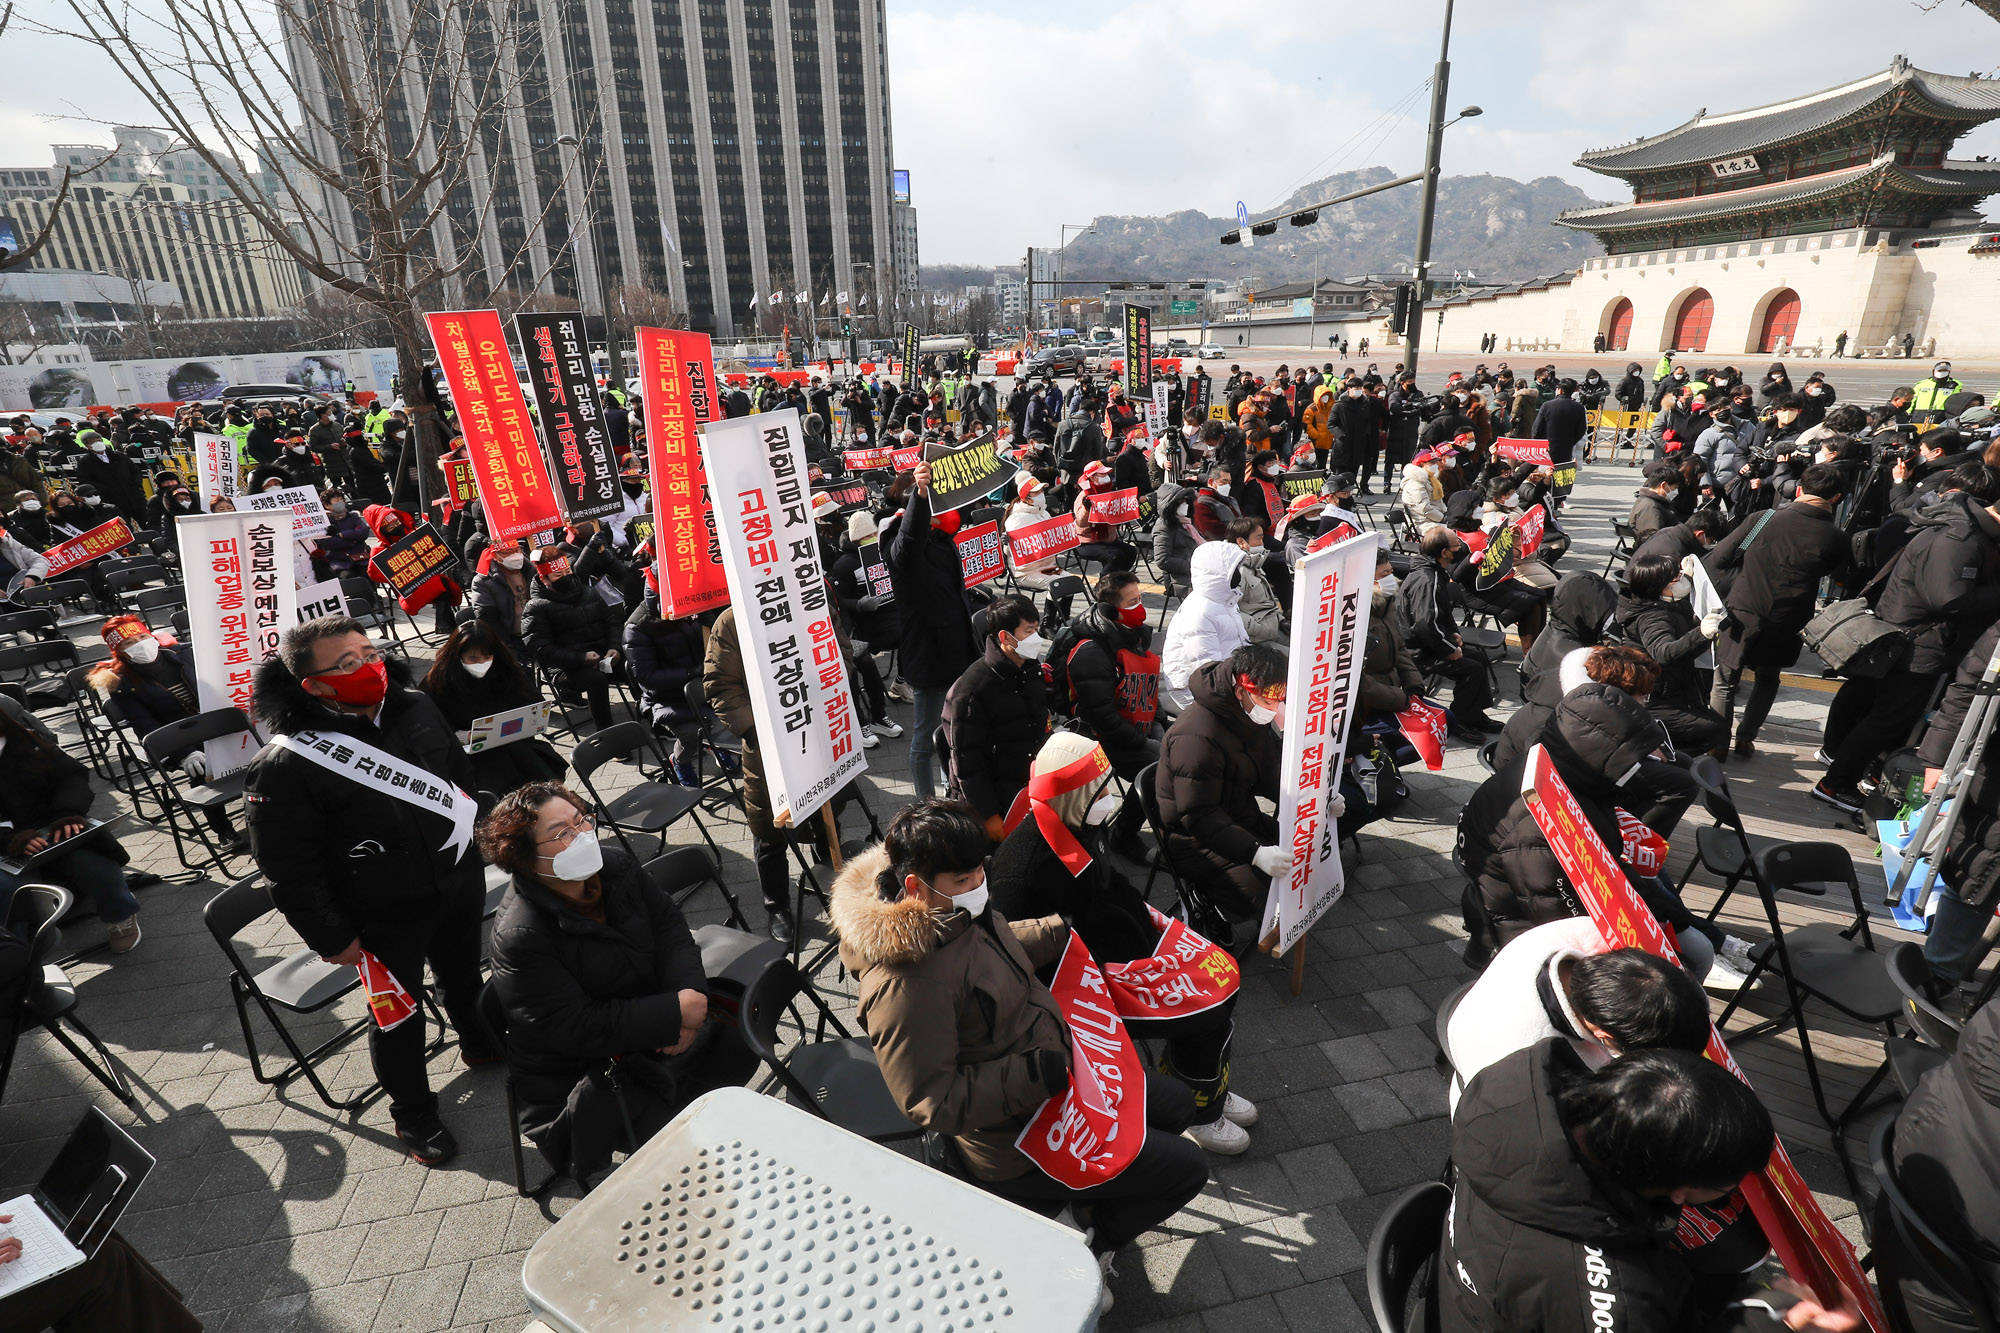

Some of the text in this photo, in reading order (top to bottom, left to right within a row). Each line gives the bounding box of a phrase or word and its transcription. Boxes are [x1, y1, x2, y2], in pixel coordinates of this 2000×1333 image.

[444, 320, 483, 395] 차별정책
[470, 399, 494, 435] 즉각
[483, 439, 520, 522] 철회하라!
[479, 339, 514, 404] 우리도
[502, 408, 539, 497] 국민이다.
[533, 326, 587, 501] 생색내기 그만하라!
[558, 319, 614, 500] 쥐꼬리 만한 손실보상
[1212, 407, 1223, 419] 선
[206, 441, 219, 485] 생색내기
[220, 440, 235, 498] 쥐꼬리 만한
[655, 338, 699, 588] 관리비·고정비 전액 보상하라!
[250, 490, 307, 511] 생계형 유흥업소
[82, 535, 103, 554] 전액
[247, 522, 277, 591] 손실보상
[386, 533, 435, 573] 임대료는 정부와
[390, 561, 426, 589] 경기도청이
[421, 544, 450, 569] 지급하라
[981, 530, 999, 549] 죽으면
[983, 548, 1000, 569] 죽는다
[209, 537, 246, 610] 피해업종
[763, 426, 852, 763] 집합금지 제한중 임대료·관리비
[254, 593, 280, 628] 예산
[738, 487, 813, 755] 고정비, 전액 보상하라!
[219, 612, 253, 667] 위주로
[1304, 571, 1339, 736] 관리비·고정비
[1299, 745, 1323, 790] 전액
[1290, 797, 1319, 911] 보상하라!
[1198, 950, 1238, 988] 전액
